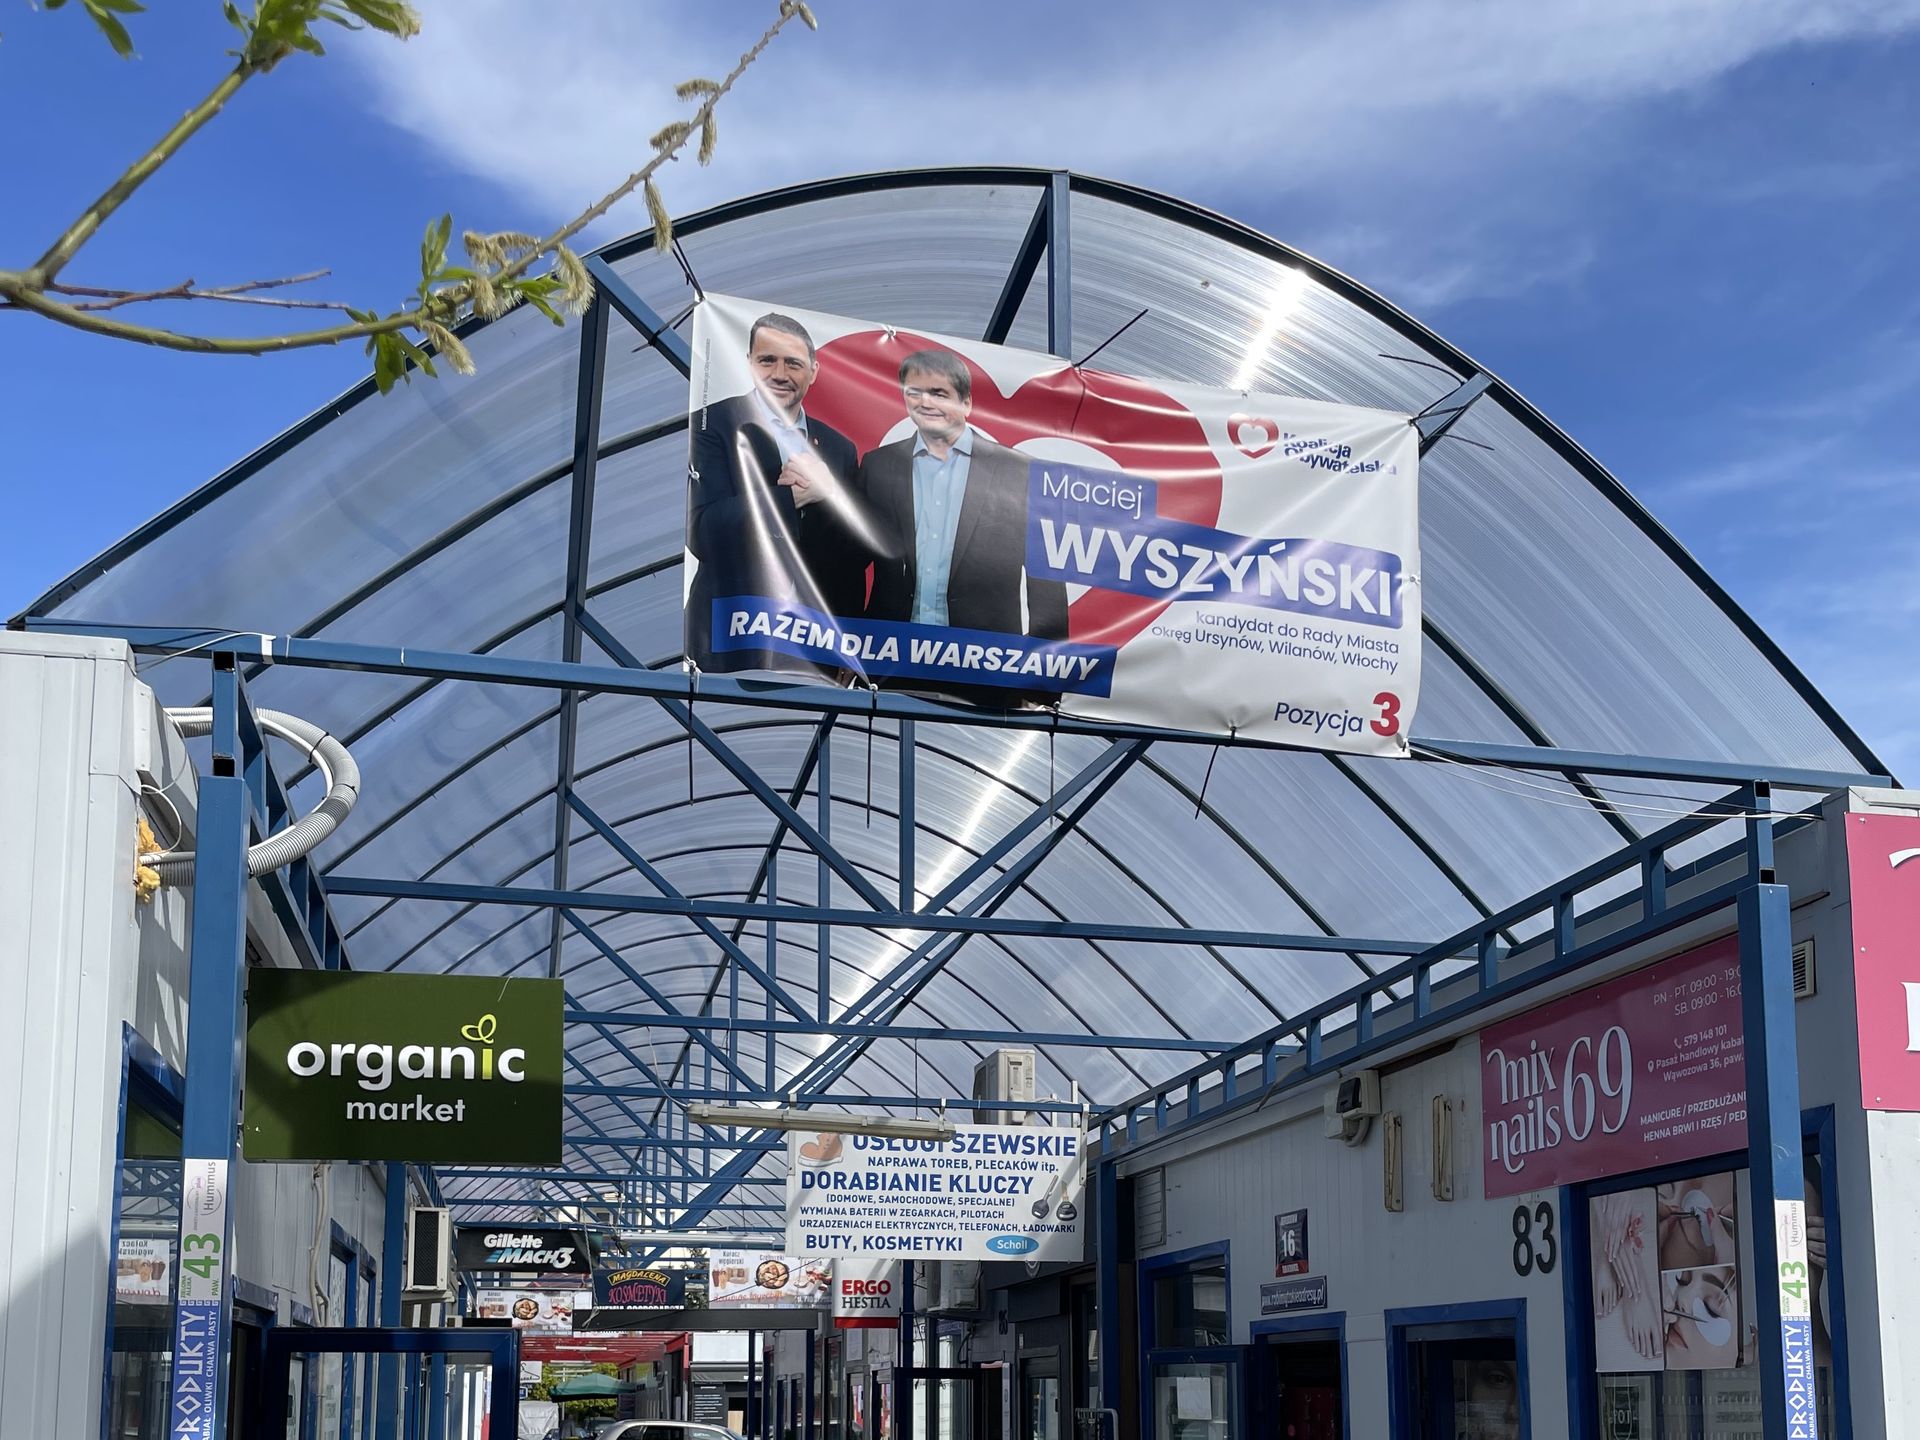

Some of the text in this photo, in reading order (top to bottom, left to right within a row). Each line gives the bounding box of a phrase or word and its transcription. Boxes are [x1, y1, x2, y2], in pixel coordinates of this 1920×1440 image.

[1042, 471, 1142, 519] Maciej
[1039, 518, 1392, 617] WYSZYŃSKI
[729, 610, 1100, 681] RAZEM DLA WARSZAWY
[1195, 611, 1399, 654] kandydat do Rady Miasta
[1194, 628, 1265, 654] Ursynów,
[1268, 638, 1338, 666] Wilanów,
[1341, 650, 1398, 675] Włochy
[1273, 691, 1401, 737] Pozycja 3
[1653, 992, 1667, 1006] PN
[1683, 1024, 1727, 1046] 579 148 101
[287, 1014, 525, 1091] organic
[1656, 1053, 1678, 1069] Pasaż
[1679, 1044, 1719, 1063] handlowy
[1486, 1040, 1557, 1105] mix
[1562, 1025, 1633, 1142] 69
[1663, 1063, 1708, 1082] Wąwozowa
[346, 1094, 466, 1122] market
[1640, 1107, 1681, 1126] MANICURE
[1490, 1096, 1562, 1174] nails
[1643, 1127, 1671, 1143] HENNA
[1672, 1121, 1695, 1136] BRWI
[1700, 1115, 1721, 1130] RZĘS
[1728, 1110, 1747, 1123] PED
[853, 1132, 1077, 1157] USŁUGI SZEWSKIE
[867, 1156, 1059, 1173] NAPRAWA TOREB, PLECAKÓW itp.
[203, 1161, 217, 1211] Hummus
[801, 1170, 1034, 1195] DORABIANIE KLUCZY
[800, 1206, 1005, 1219] WYMIANA BATERII W ZEGARKACH, PILOTACH
[826, 1194, 1015, 1208] (DOMOWE, SAMOCHODOWE, SPECJALNE)
[875, 1221, 957, 1231] ELEKTRYCZNYCH,
[959, 1222, 1021, 1233] TELEFONACH,
[1022, 1223, 1076, 1233] ŁADOWARKI
[1790, 1202, 1798, 1244] Hummus
[484, 1233, 544, 1249] Gillette
[805, 1234, 963, 1252] BUTY, KOSMETYKI
[996, 1239, 1028, 1250] Scholl
[1281, 1229, 1296, 1257] 16
[1512, 1201, 1557, 1277] 83
[183, 1233, 221, 1279] 43
[497, 1247, 576, 1269] MACH3
[612, 1270, 668, 1284] MAGDALENA
[841, 1280, 892, 1296] ERGO
[1780, 1261, 1807, 1299] 43
[608, 1282, 667, 1304] KOSMETYKI
[842, 1296, 891, 1309] HESTIA
[208, 1311, 217, 1336] PASTY
[206, 1341, 216, 1377] CHAŁWA
[1785, 1325, 1808, 1438] PRODUKTY
[203, 1382, 213, 1413] OLIWKI
